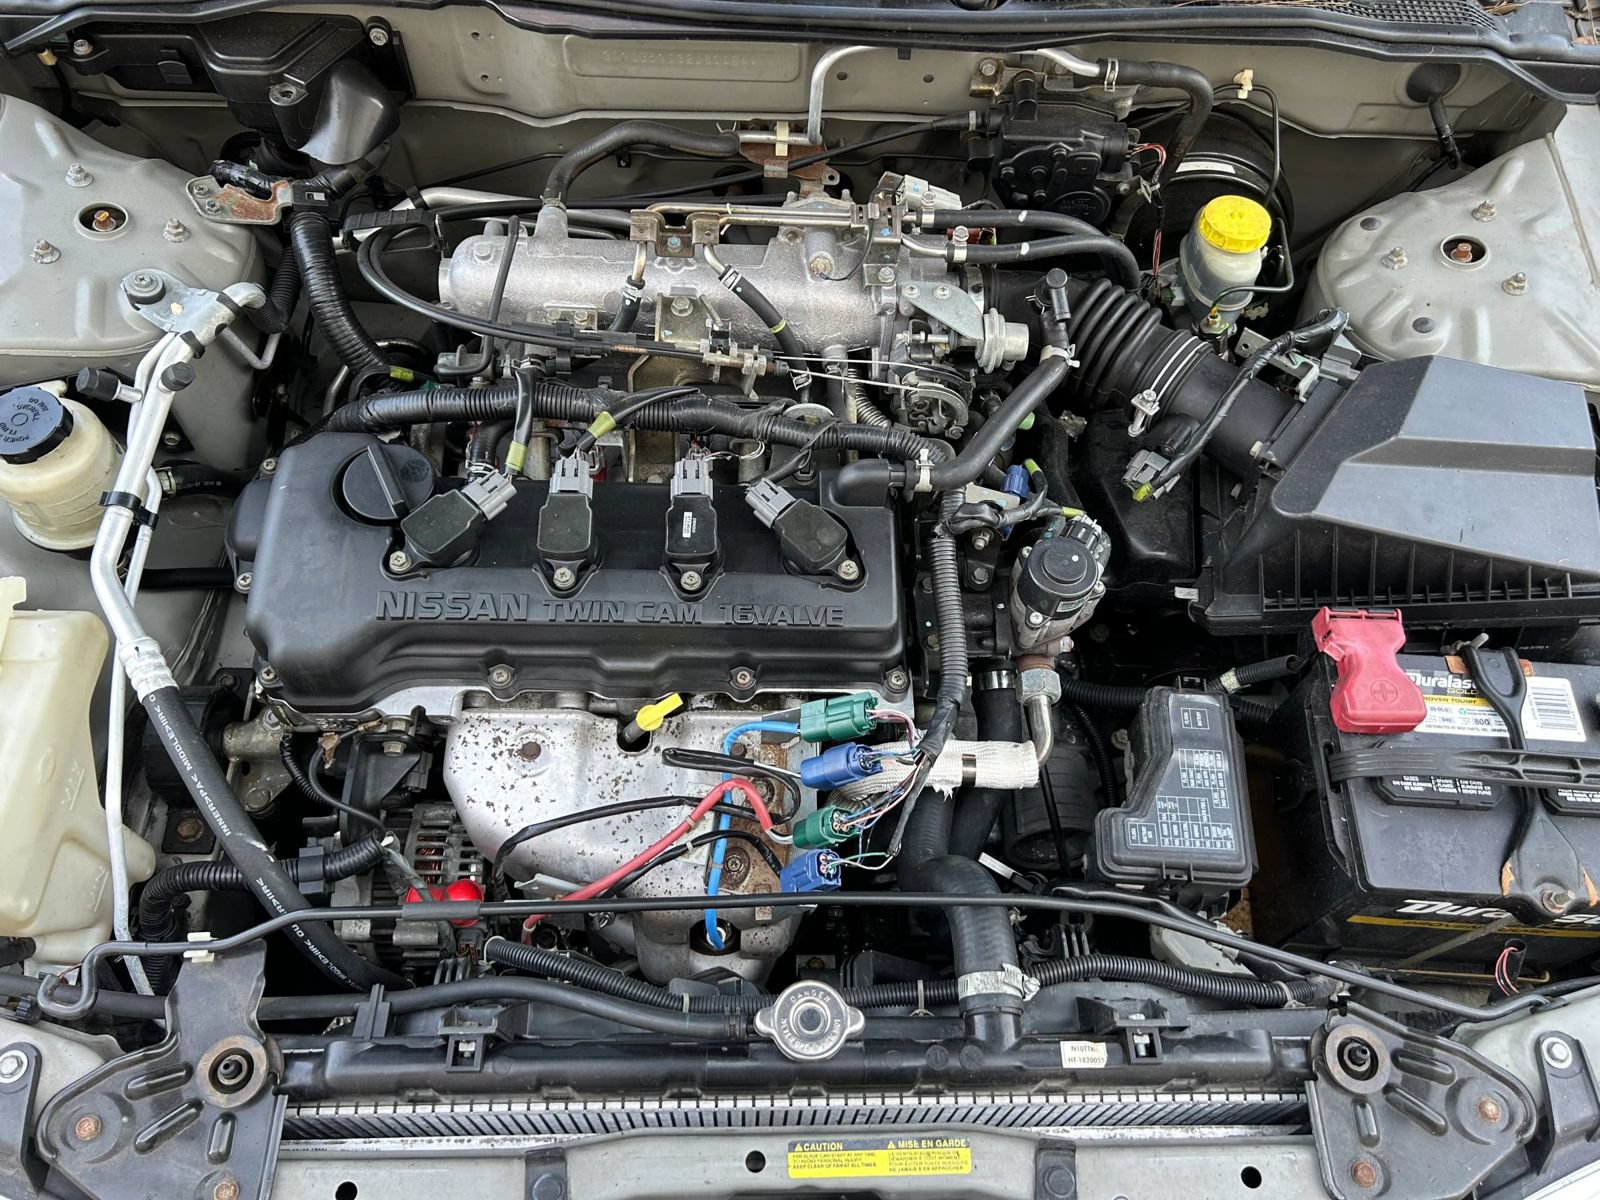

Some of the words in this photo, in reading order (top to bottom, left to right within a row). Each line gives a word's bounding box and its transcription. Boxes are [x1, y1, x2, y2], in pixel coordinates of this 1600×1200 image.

[376, 591, 529, 622] NISSAN
[543, 600, 625, 623] TWIN
[635, 602, 703, 624] CAM
[719, 603, 844, 627] 16VALVE
[1405, 672, 1477, 689] Duralas
[790, 989, 831, 1003] DANGER
[803, 1142, 843, 1151] CAUTION
[898, 1140, 919, 1149] MISE
[921, 1139, 934, 1148] EN
[936, 1138, 967, 1148] GARDE
